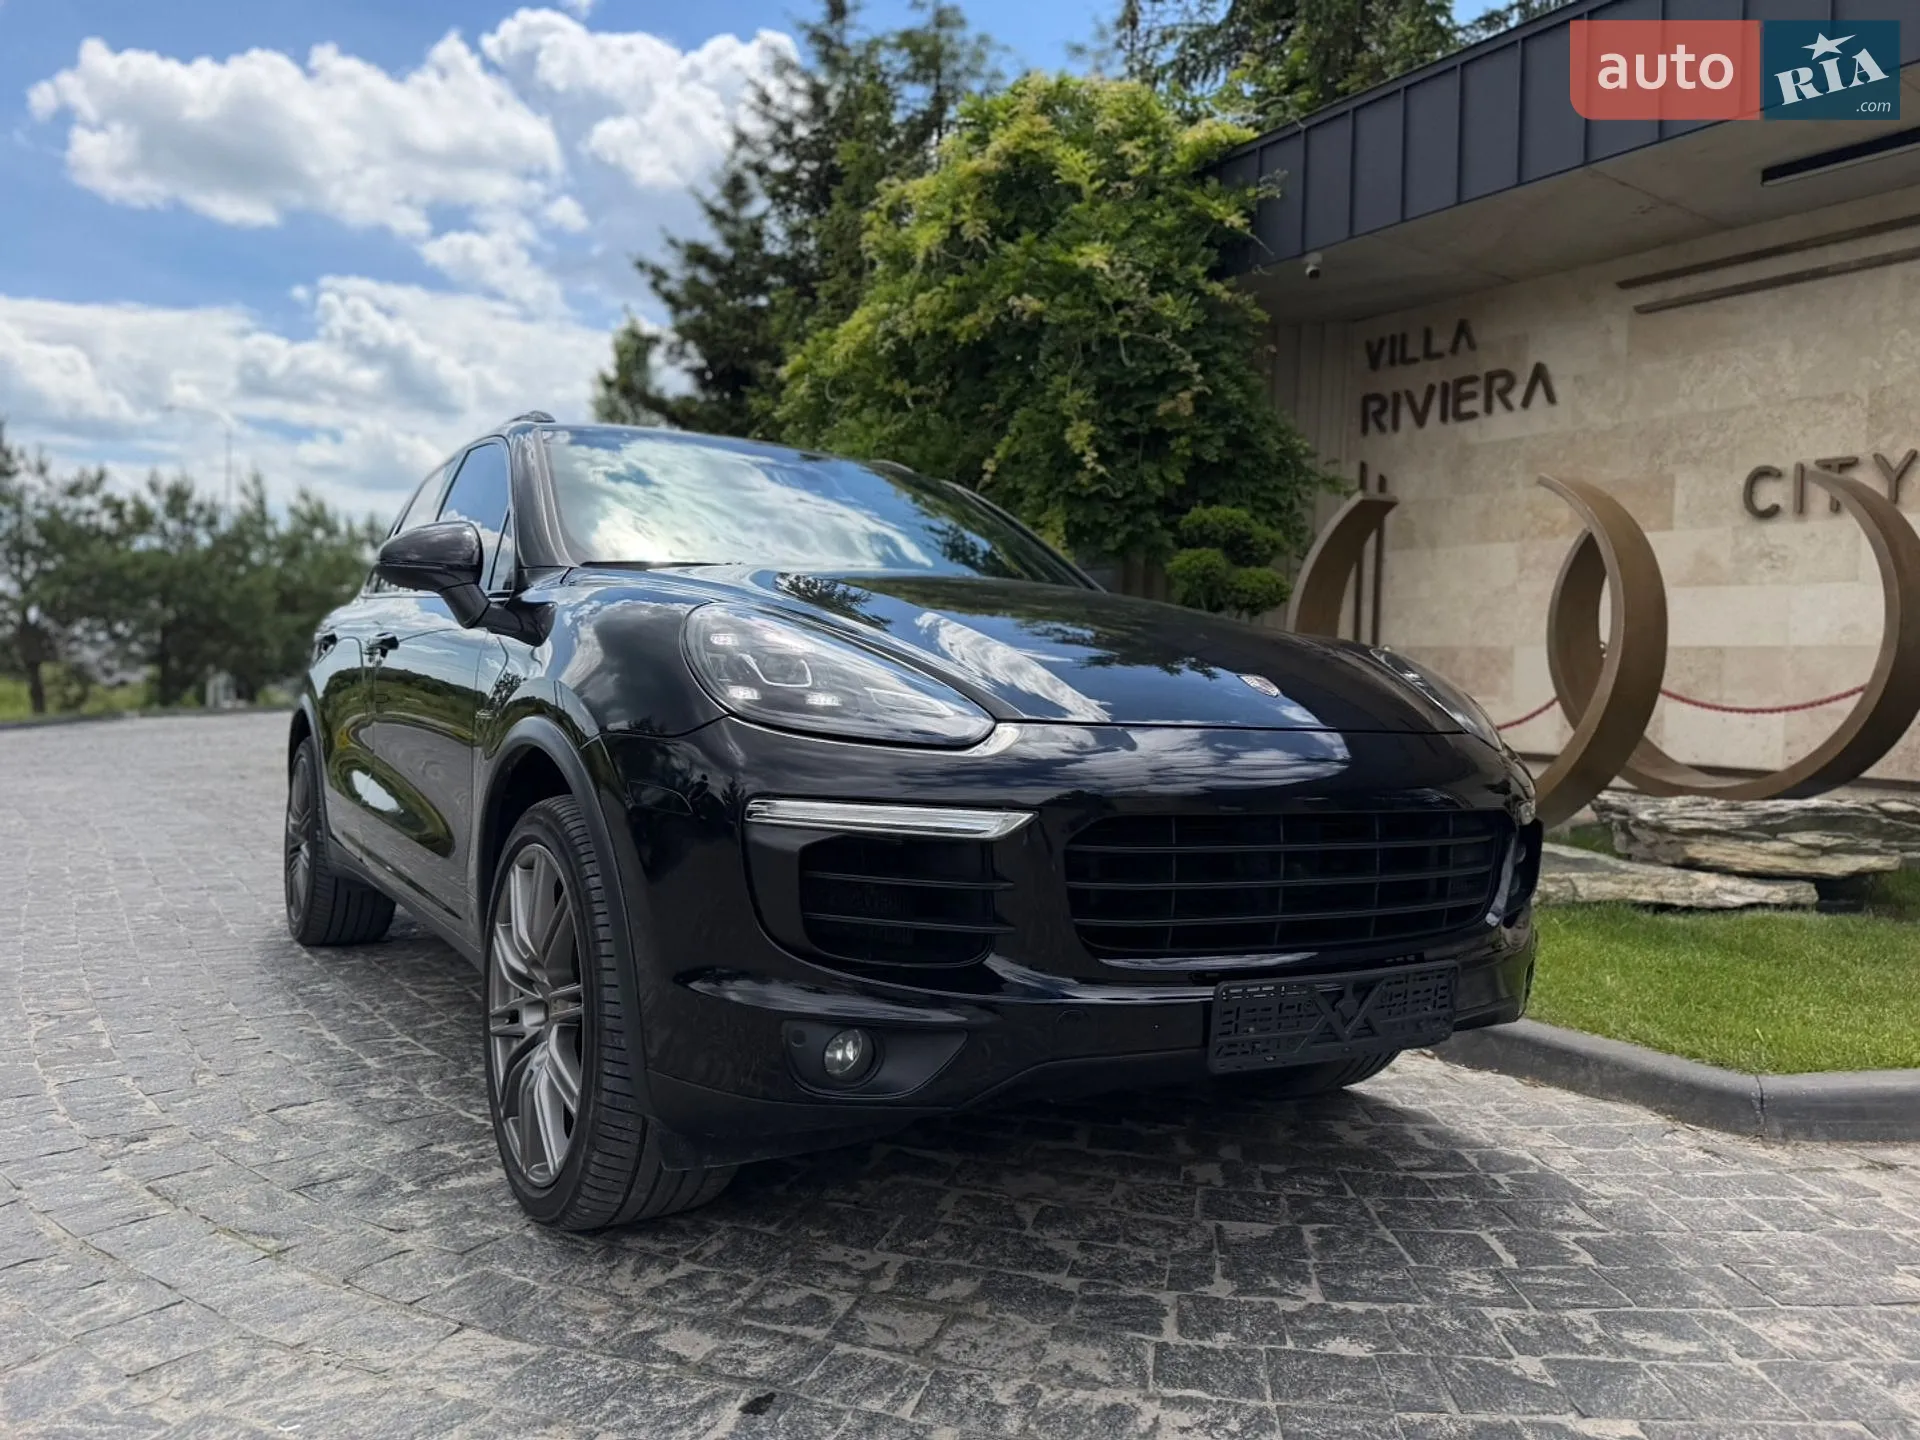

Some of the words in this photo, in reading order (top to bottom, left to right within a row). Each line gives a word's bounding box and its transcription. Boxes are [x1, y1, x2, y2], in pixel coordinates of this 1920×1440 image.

[1364, 318, 1477, 372] VILLA
[1360, 361, 1558, 437] RIVIERA
[1742, 448, 1919, 519] CITY
